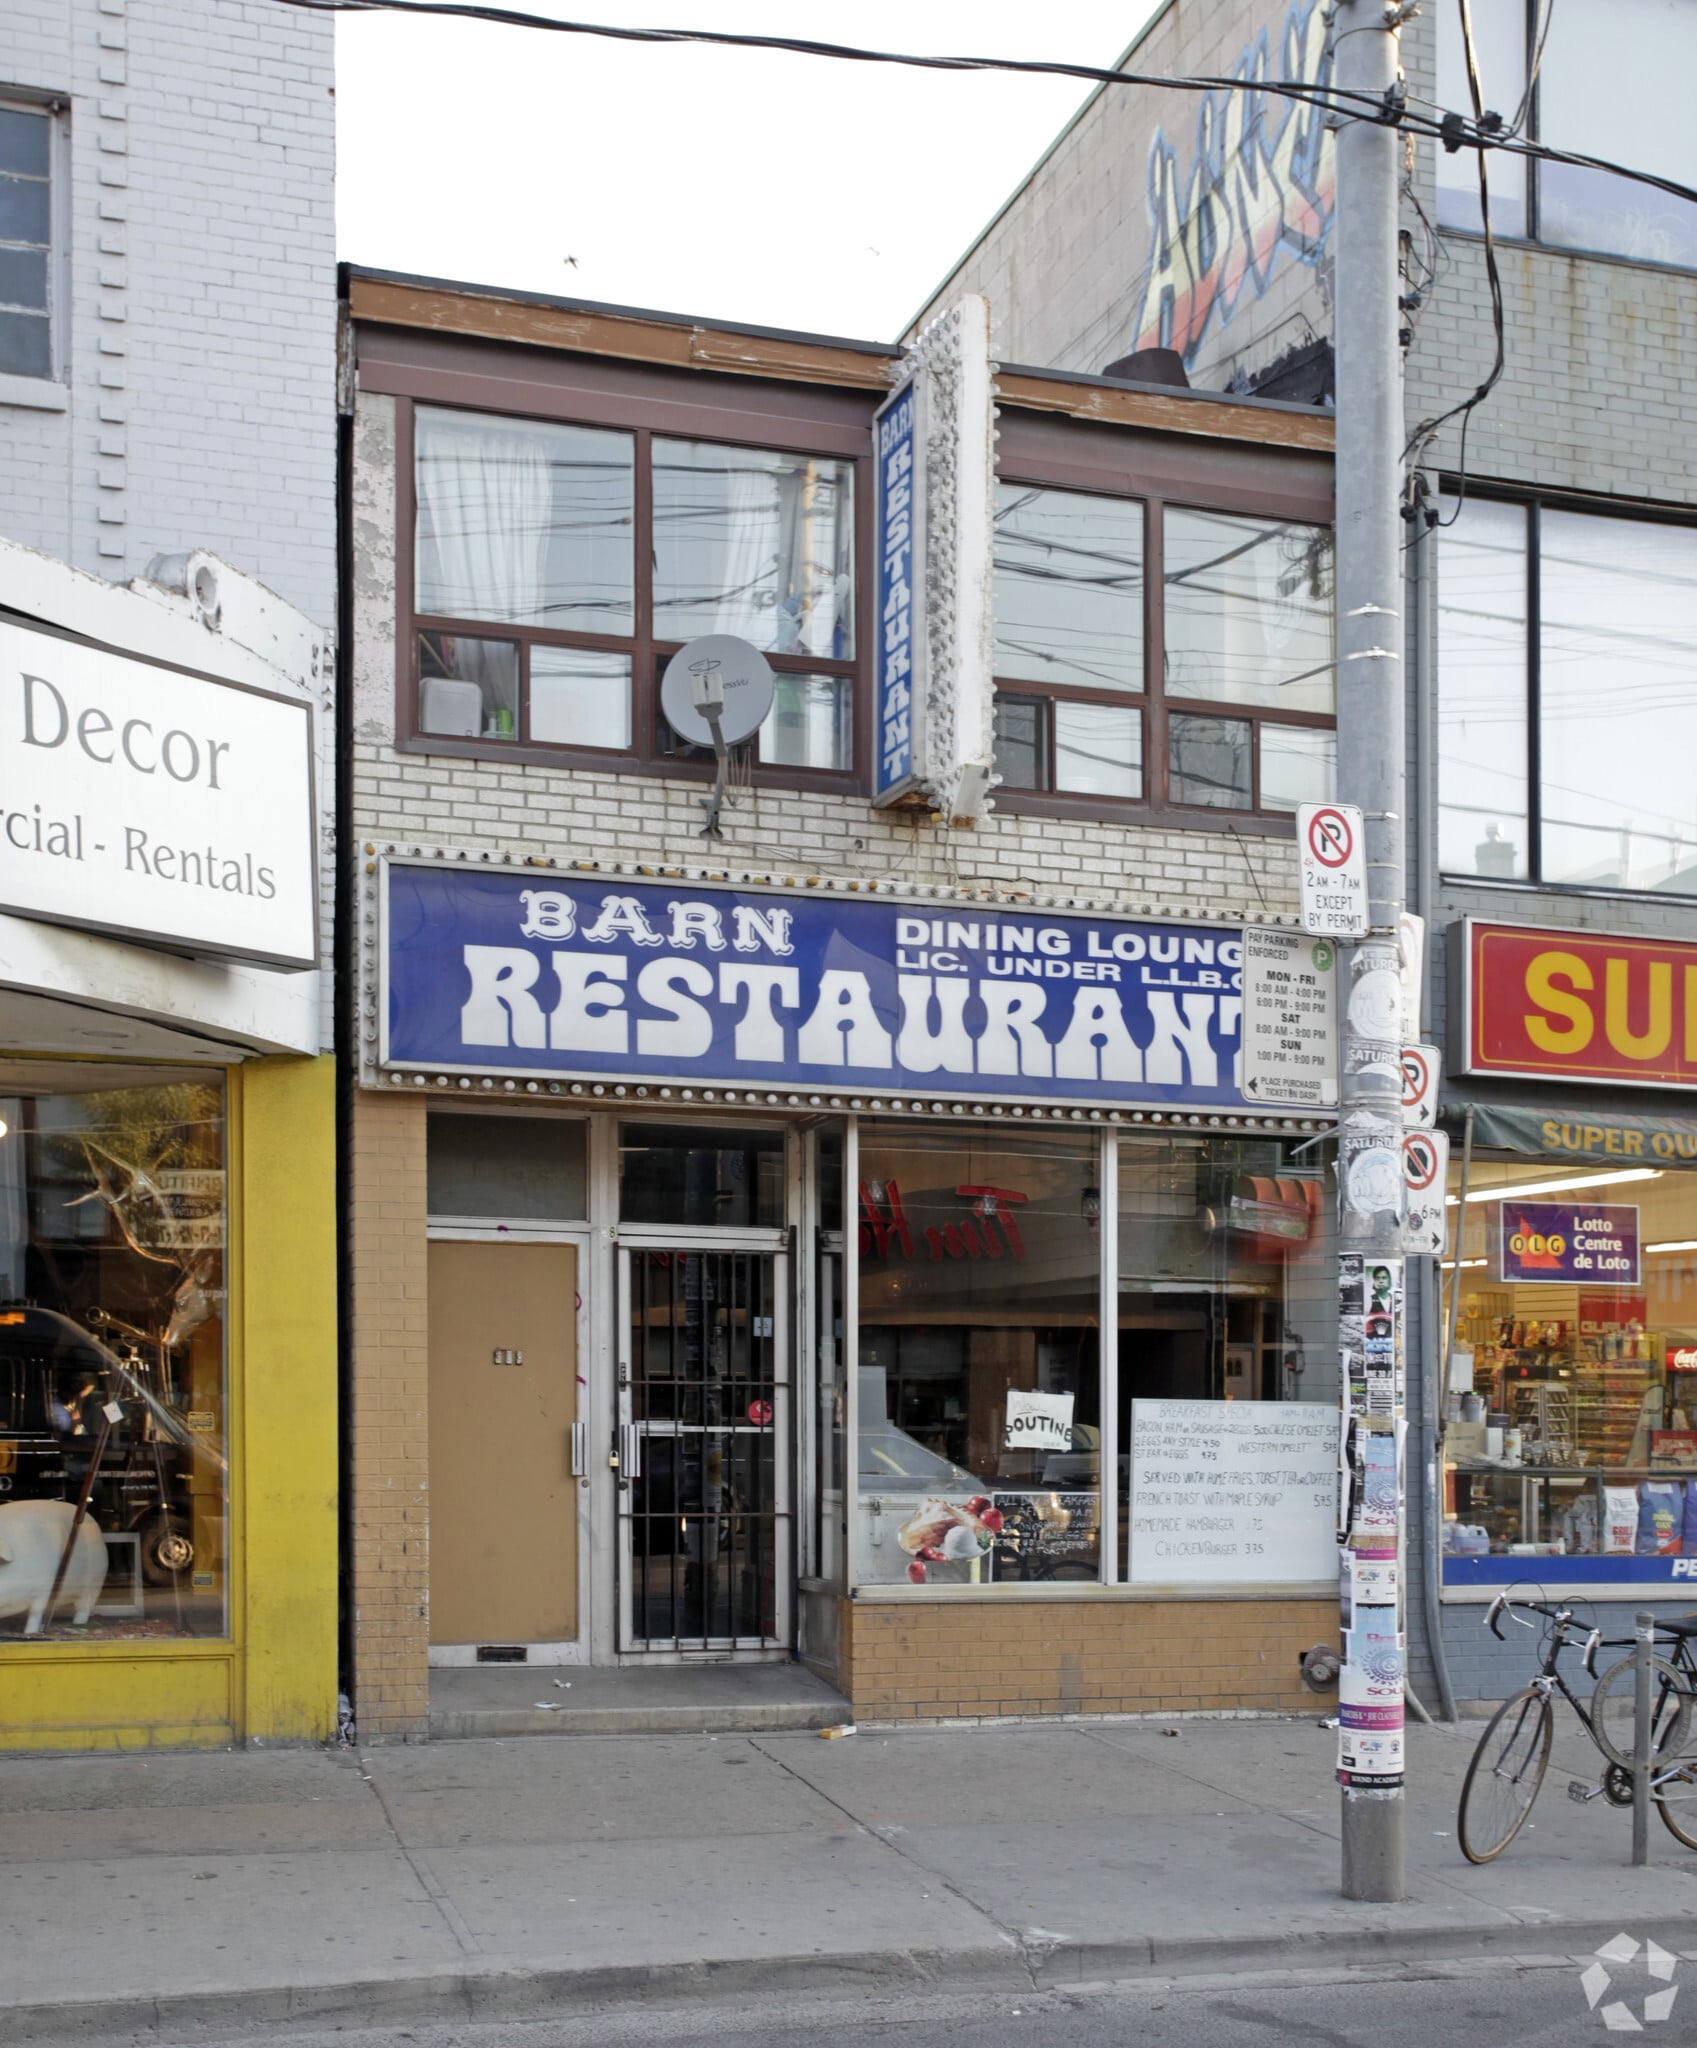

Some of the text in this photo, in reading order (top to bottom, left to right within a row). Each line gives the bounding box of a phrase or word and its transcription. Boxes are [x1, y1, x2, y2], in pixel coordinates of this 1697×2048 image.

[882, 440, 913, 782] RESTAURANT
[20, 672, 230, 790] Decor
[0, 803, 85, 862] cial
[124, 826, 276, 900] Rentals
[1316, 894, 1353, 910] EXCEPT
[519, 889, 794, 956] BARN
[1309, 912, 1363, 929] BY PERMIT
[896, 917, 1242, 967] DINING LOUNG
[1248, 932, 1299, 949] PAY PARKING
[1248, 946, 1289, 960] ENFORCED
[896, 949, 969, 973] LIC.
[987, 956, 1121, 983] UNDER
[1266, 970, 1291, 983] MON
[1299, 974, 1316, 985] FRI
[1274, 985, 1289, 995] AM
[1313, 989, 1327, 1000] PM
[1275, 999, 1288, 1009] PM
[1312, 1003, 1326, 1013] PM
[1281, 1012, 1301, 1024] SAT
[1274, 1026, 1288, 1036] AM
[1313, 1029, 1327, 1040] PM
[1280, 1039, 1302, 1050] SUN
[1274, 1052, 1287, 1062] PM
[1312, 1056, 1326, 1066] PM
[1349, 1049, 1400, 1065] SATURD
[1261, 1077, 1322, 1090] PLACE PURCHASED
[1265, 1088, 1318, 1100] TICKET ON DASH
[1344, 1136, 1398, 1151] SATURD
[1542, 1120, 1645, 1156] SUPER
[1573, 1216, 1613, 1233] Lotto
[1511, 1234, 1564, 1255] OLG
[1573, 1235, 1623, 1252] Centre
[1573, 1253, 1631, 1270] de Loto
[1004, 1415, 1073, 1444] POUTINE
[1178, 1437, 1201, 1448] STYLE
[1134, 1449, 1162, 1460] STEAK
[1168, 1449, 1190, 1462] EGGS
[1143, 1470, 1181, 1485] SERVED
[1183, 1471, 1206, 1485] WITH
[1303, 1471, 1335, 1487] COFFEE
[1136, 1491, 1172, 1506] FRENCH
[1172, 1491, 1201, 1506] TOAST
[1203, 1491, 1226, 1506] WITH
[1226, 1492, 1253, 1507] MAPLE
[1134, 1517, 1182, 1533] HOMEMADE
[1185, 1516, 1236, 1534] HAMBURGER
